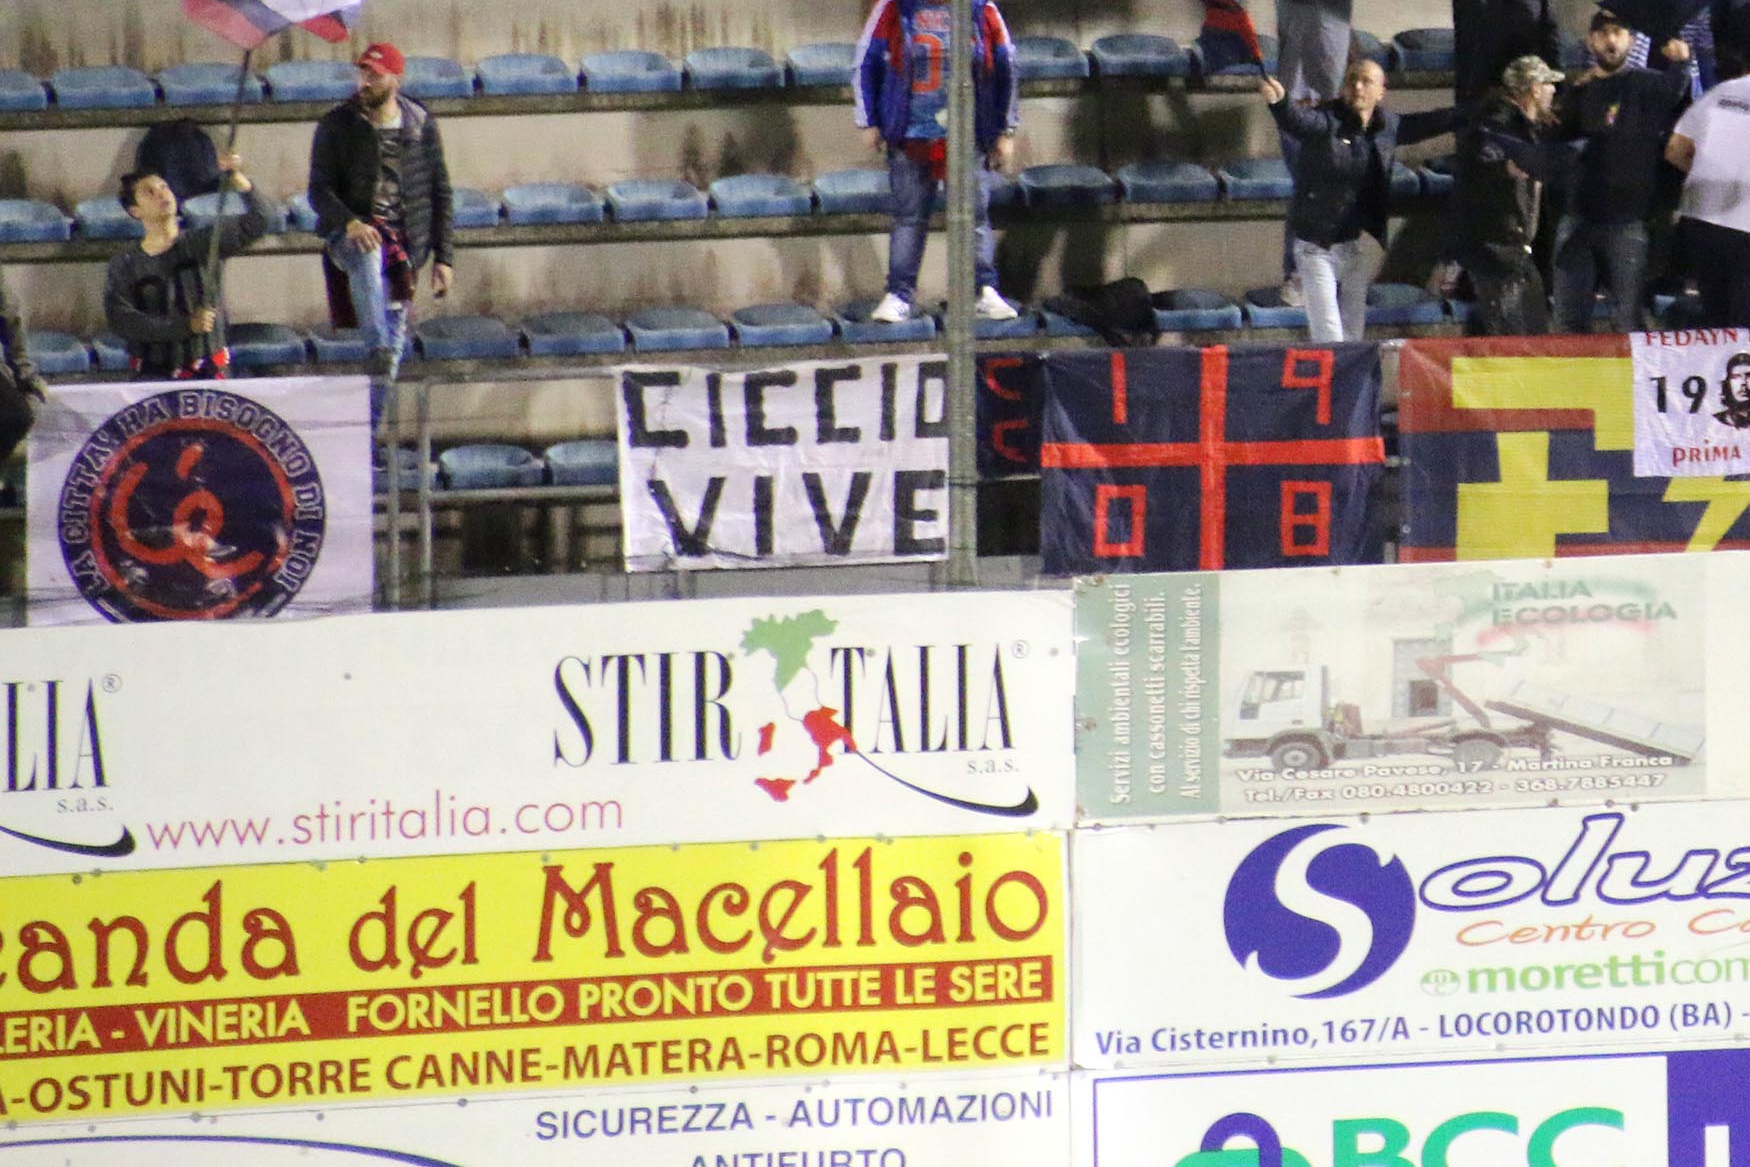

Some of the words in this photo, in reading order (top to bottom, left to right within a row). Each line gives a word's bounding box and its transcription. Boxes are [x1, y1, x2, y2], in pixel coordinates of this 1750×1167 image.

[116, 396, 172, 436] HA
[180, 391, 311, 477] BISOGNO
[293, 482, 322, 520] DI
[647, 470, 946, 556] VIVE
[273, 530, 320, 592] NOI
[1493, 580, 1593, 601] ITALIA
[1493, 602, 1677, 625] ECOLOGIA
[1108, 584, 1136, 656] ecologici
[1144, 591, 1166, 671] scarrabili.
[1108, 661, 1130, 745] ambientali
[1143, 677, 1166, 759] cassonetti
[1179, 702, 1201, 720] chi
[966, 756, 1020, 775] s.a.s.
[1108, 751, 1130, 804] Servizi
[1150, 765, 1166, 794] con
[1238, 770, 1276, 782] Via
[1281, 768, 1356, 780] Cesare
[1364, 765, 1448, 777] Pavese,
[1457, 761, 1483, 773] 17
[1508, 758, 1592, 771] Martina
[1600, 755, 1673, 768] Franca
[57, 797, 114, 813] s.a.s.
[1246, 788, 1333, 803] Tel./Fax
[1342, 782, 1494, 800] 080.4800422
[146, 789, 624, 850] www.stiritalia.com
[0, 879, 301, 994] anda
[348, 881, 480, 979] del
[532, 846, 1049, 964] Macellaio
[1455, 914, 1657, 947] Centro
[0, 1011, 102, 1056] ERIA
[135, 999, 311, 1048] VINERIA
[347, 985, 565, 1033] FORNELLO
[578, 975, 753, 1019] PRONTO
[766, 969, 882, 1009] TUTTE
[896, 967, 936, 1005] LE
[948, 962, 1043, 1002] SERE
[1096, 1029, 1143, 1056] Via
[1438, 1003, 1660, 1038] LOCOROTONDO
[1670, 999, 1732, 1031] (BA)
[536, 1102, 754, 1140] SICUREZZA
[788, 1090, 1053, 1128] AUTOMAZIONI
